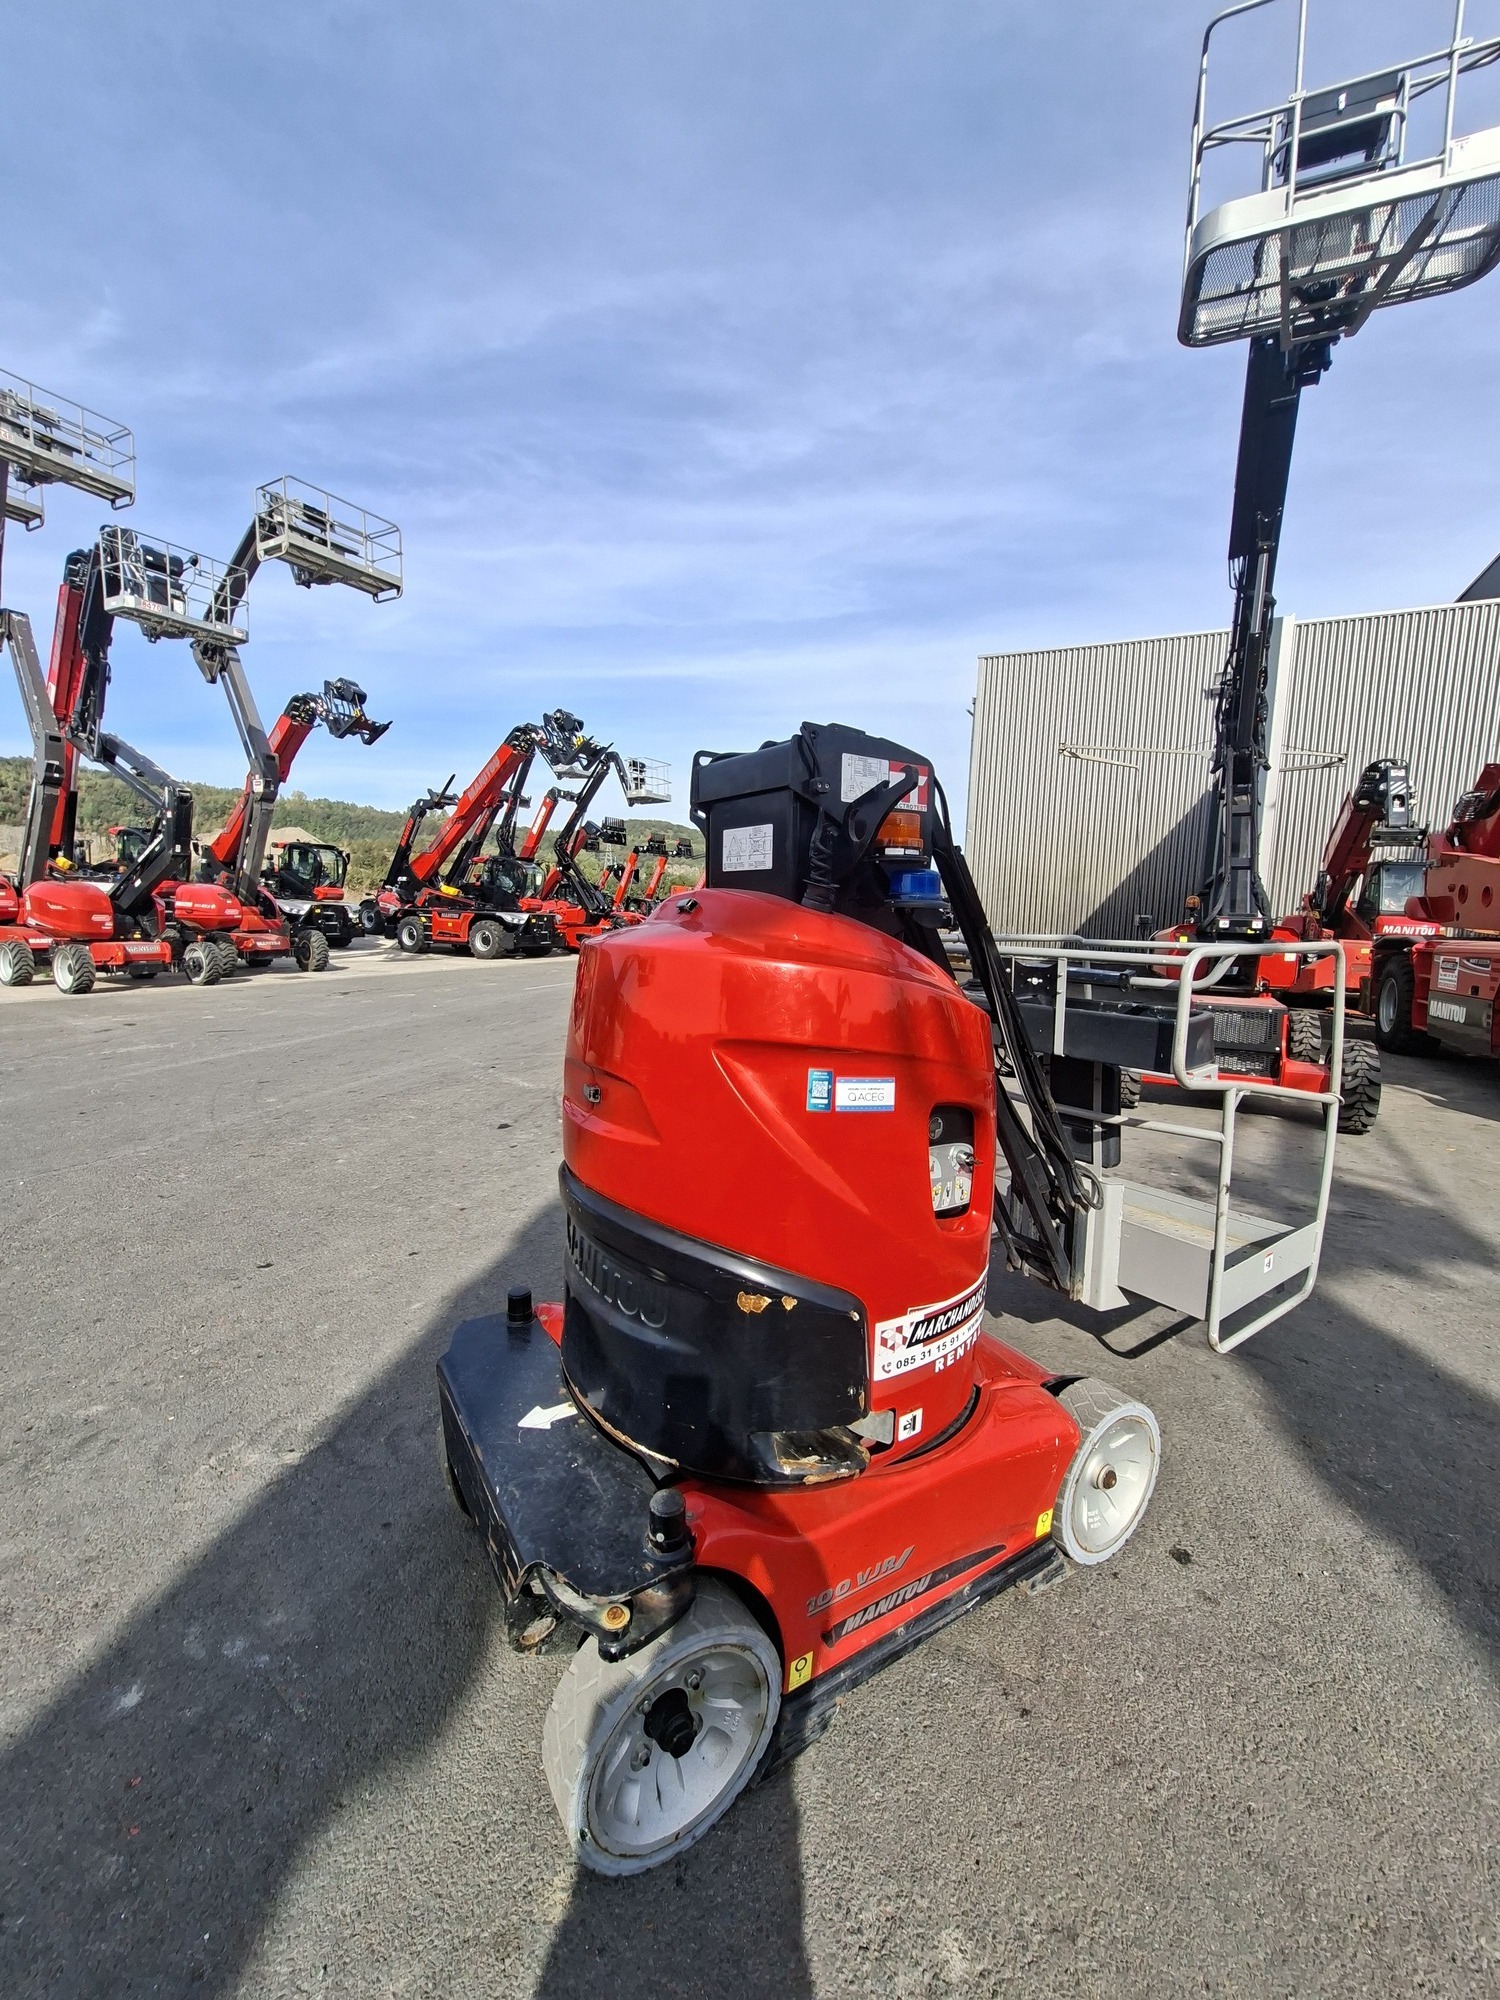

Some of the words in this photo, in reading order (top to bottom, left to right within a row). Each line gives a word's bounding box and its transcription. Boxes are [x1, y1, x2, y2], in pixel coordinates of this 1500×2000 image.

[467, 756, 500, 801] MANITOU
[1382, 924, 1436, 936] MANITOU
[1429, 1000, 1467, 1023] MANITOU
[896, 1355, 916, 1369] 085
[920, 1349, 931, 1360] 31
[937, 1341, 947, 1353] 15
[950, 1334, 960, 1346] 91
[806, 1579, 851, 1612] 100
[857, 1555, 897, 1587] VJR
[842, 1573, 933, 1636] MANITOU
